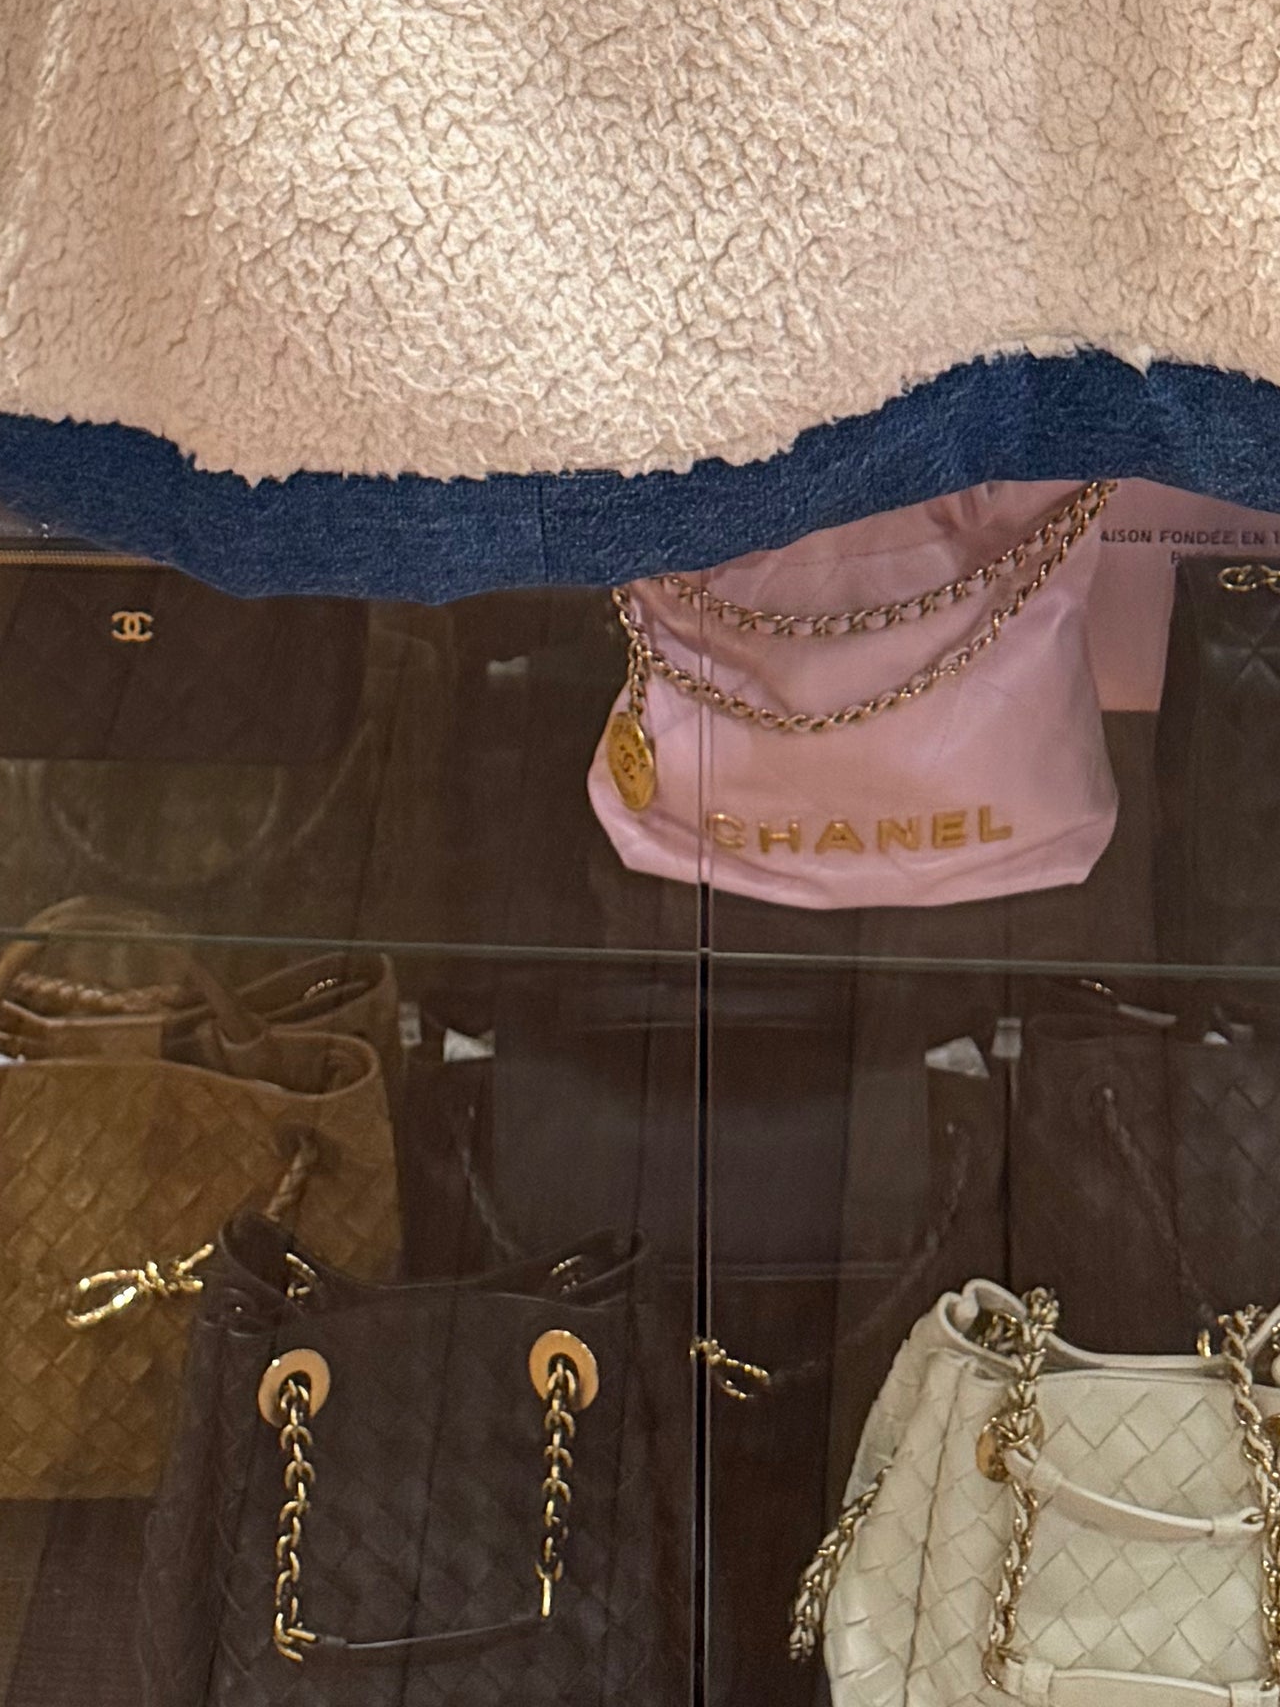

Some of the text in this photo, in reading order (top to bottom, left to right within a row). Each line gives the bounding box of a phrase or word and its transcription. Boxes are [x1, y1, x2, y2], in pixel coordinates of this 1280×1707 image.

[1100, 530, 1153, 544] AISON
[1241, 530, 1265, 545] EN
[704, 804, 1014, 856] CHANEL
